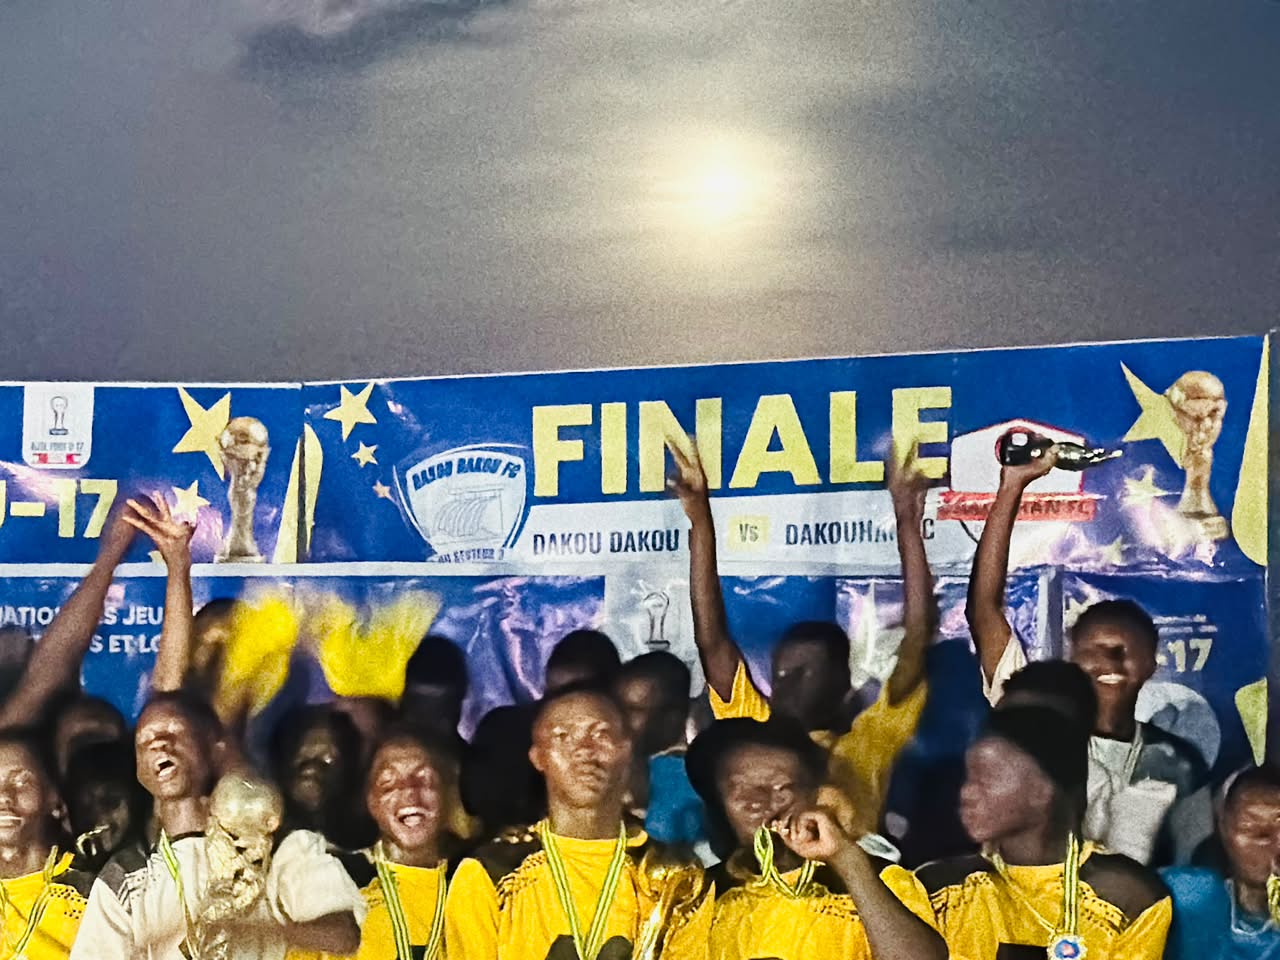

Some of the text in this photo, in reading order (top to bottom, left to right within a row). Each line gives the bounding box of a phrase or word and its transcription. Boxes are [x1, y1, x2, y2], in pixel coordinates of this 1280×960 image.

[532, 386, 952, 497] FINALE
[533, 531, 602, 556] DAKOU
[609, 529, 680, 553] DAKOU
[1155, 638, 1213, 674] -17
